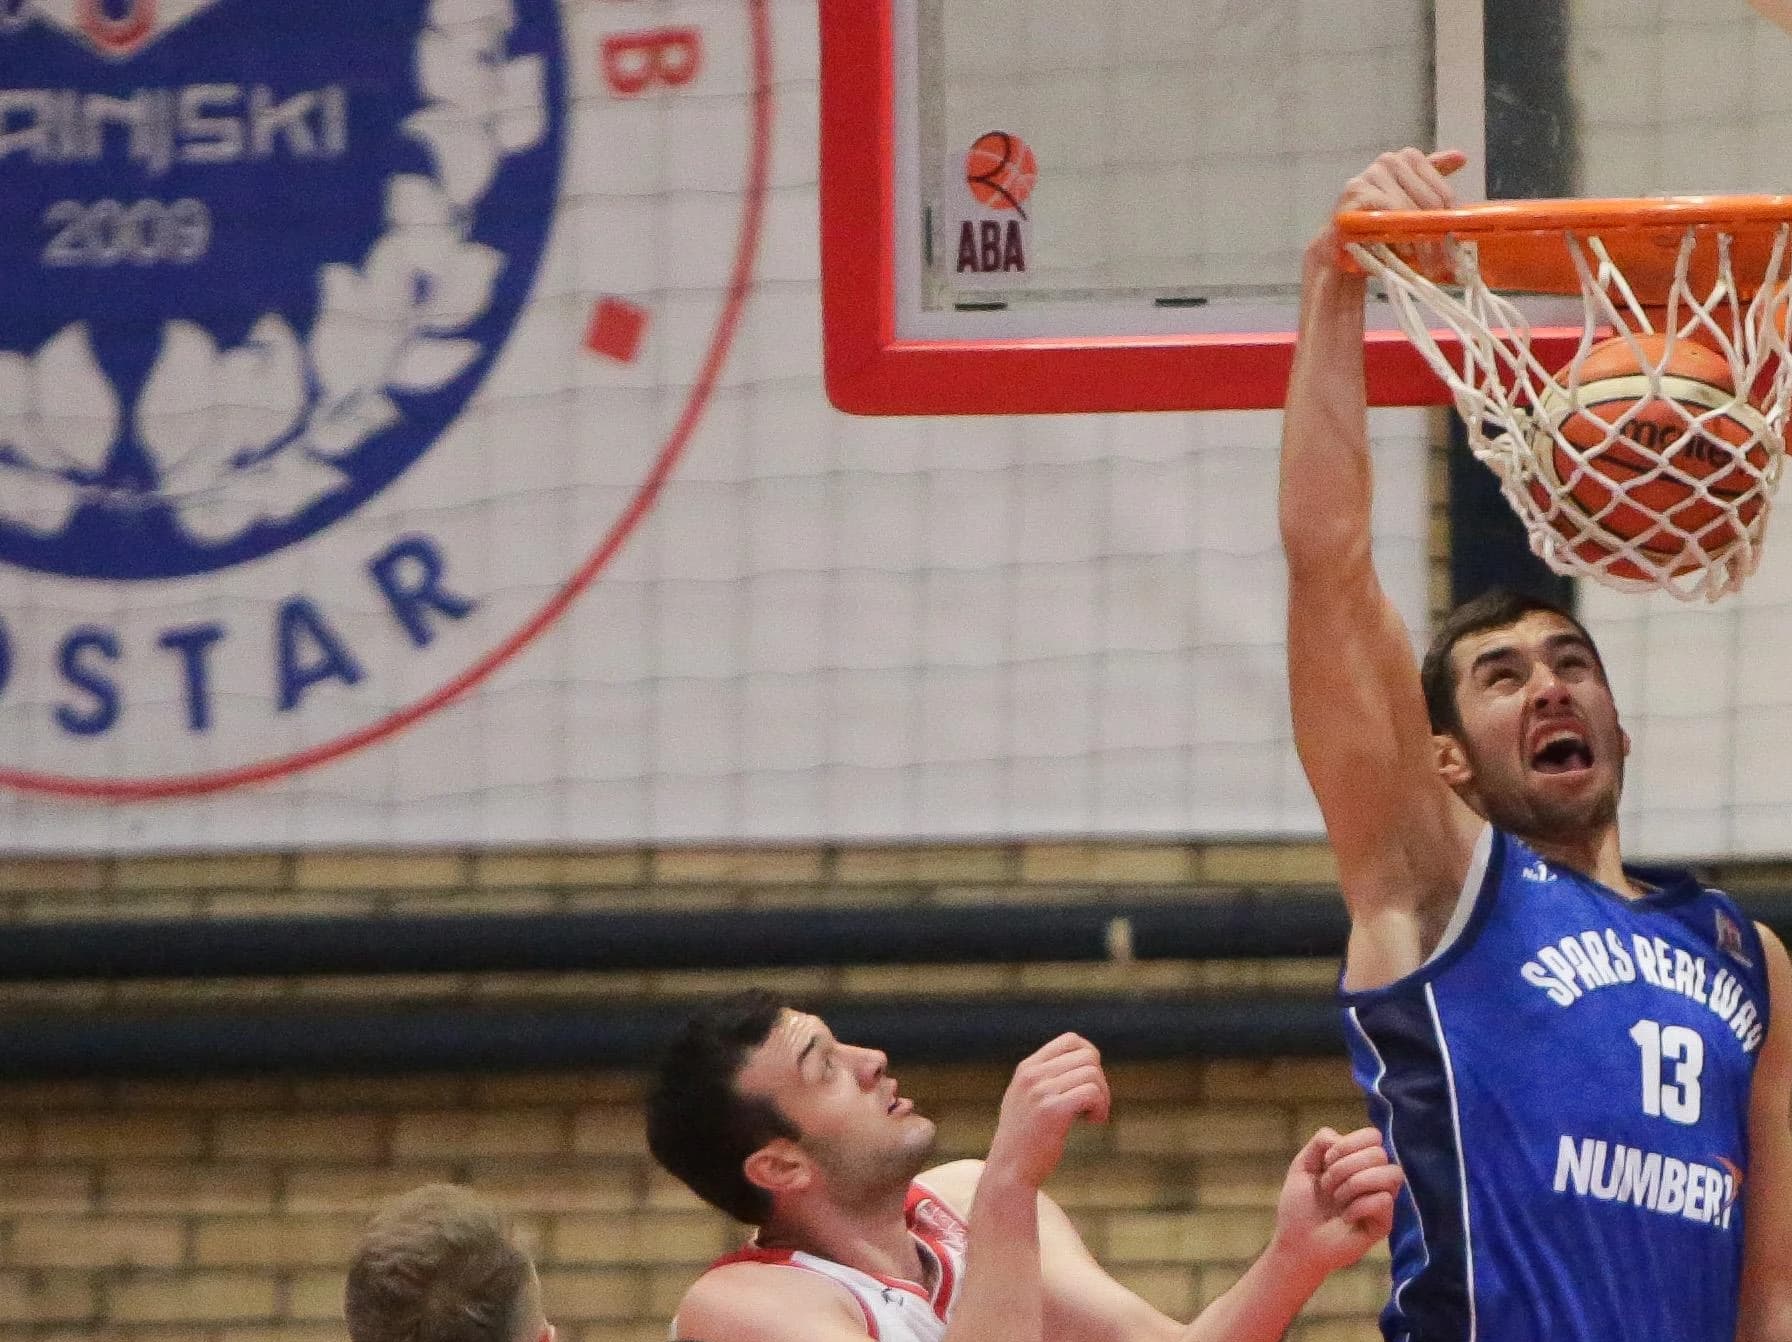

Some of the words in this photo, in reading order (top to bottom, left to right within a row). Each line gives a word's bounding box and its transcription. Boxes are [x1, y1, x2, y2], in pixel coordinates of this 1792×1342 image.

[957, 219, 1026, 273] ABA
[0, 531, 478, 737] STAR
[1520, 928, 1636, 1008] SPARS
[1629, 1018, 1705, 1126] 13
